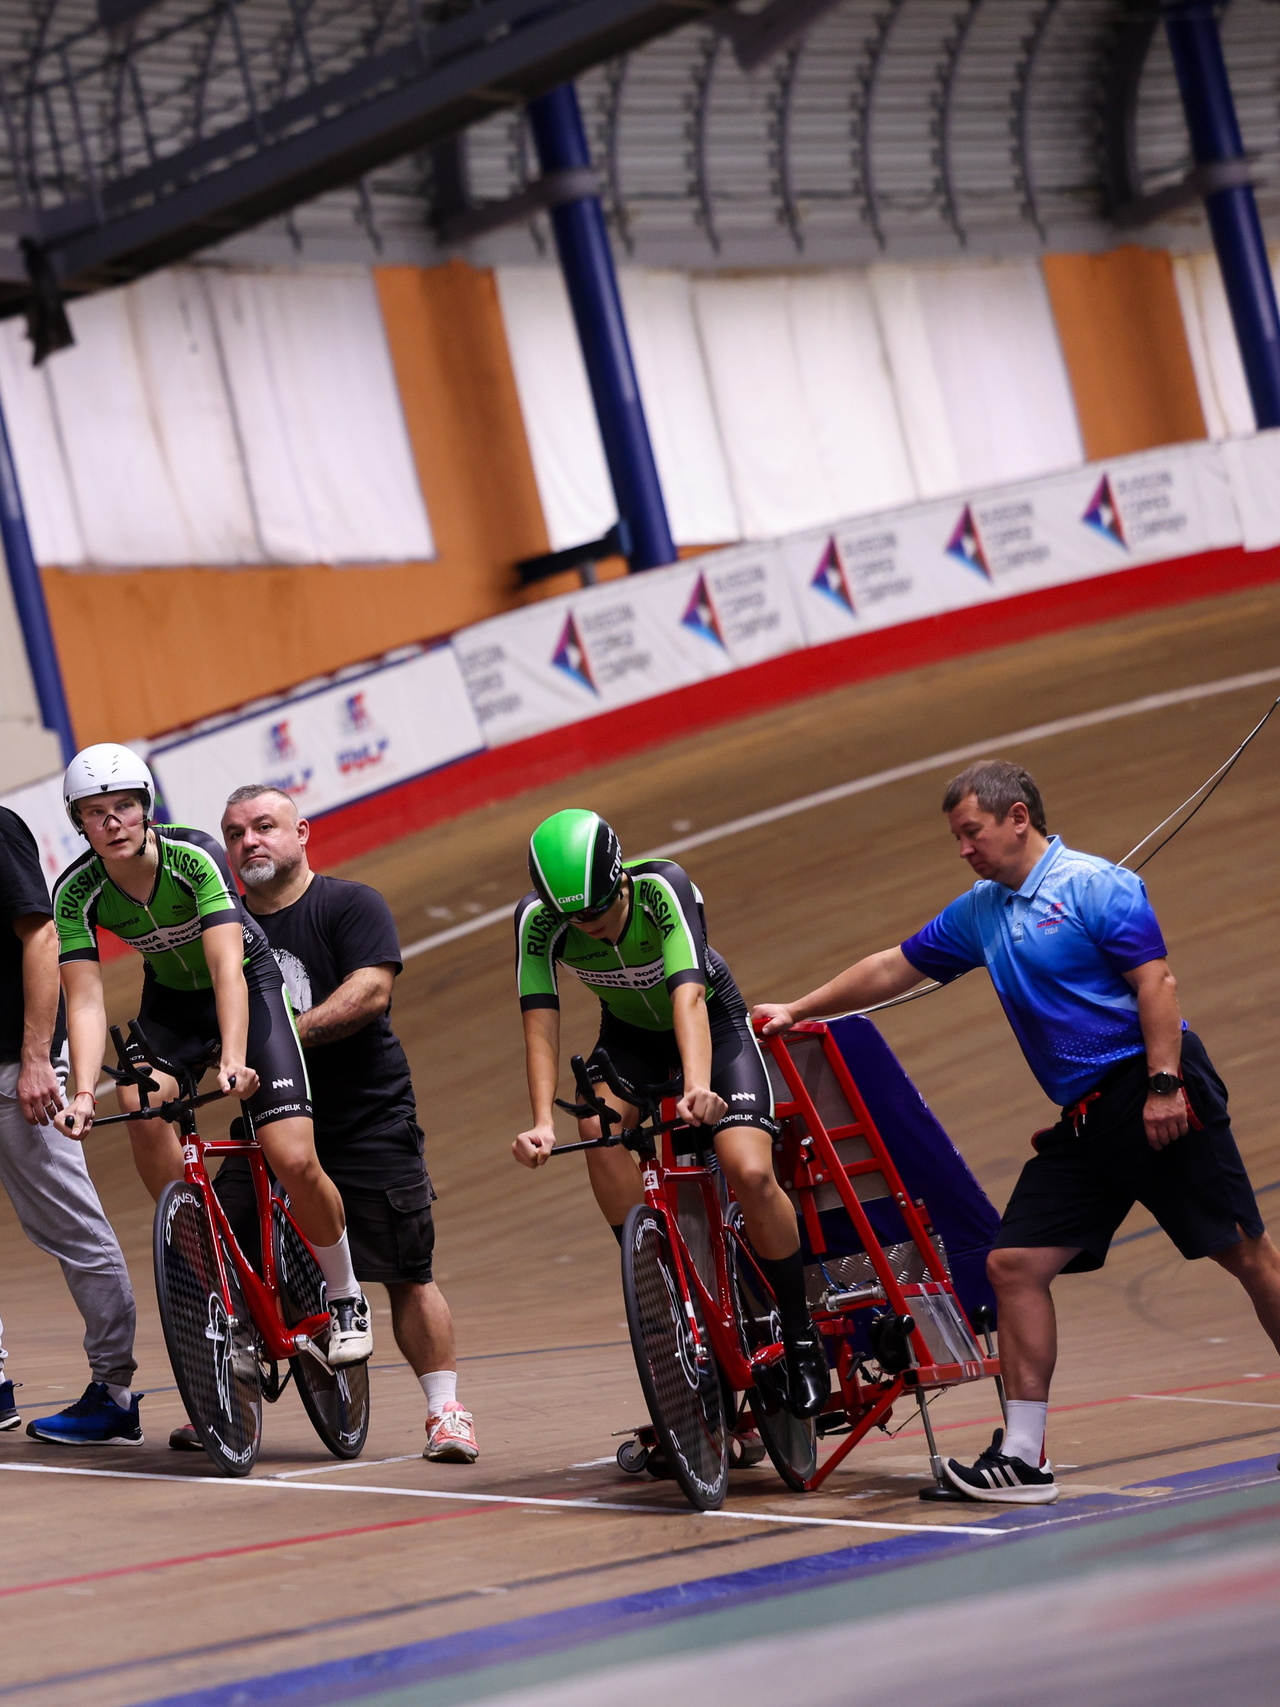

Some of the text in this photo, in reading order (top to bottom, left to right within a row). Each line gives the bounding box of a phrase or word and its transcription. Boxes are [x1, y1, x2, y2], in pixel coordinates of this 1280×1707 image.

[166, 846, 208, 886] RUSSIA
[60, 865, 103, 921] RUSSIA
[557, 893, 584, 904] GIRO
[639, 881, 676, 940] RUSSIA
[575, 969, 627, 980] RUSSIA
[254, 1103, 302, 1122] СЕСТРОРЕЦК
